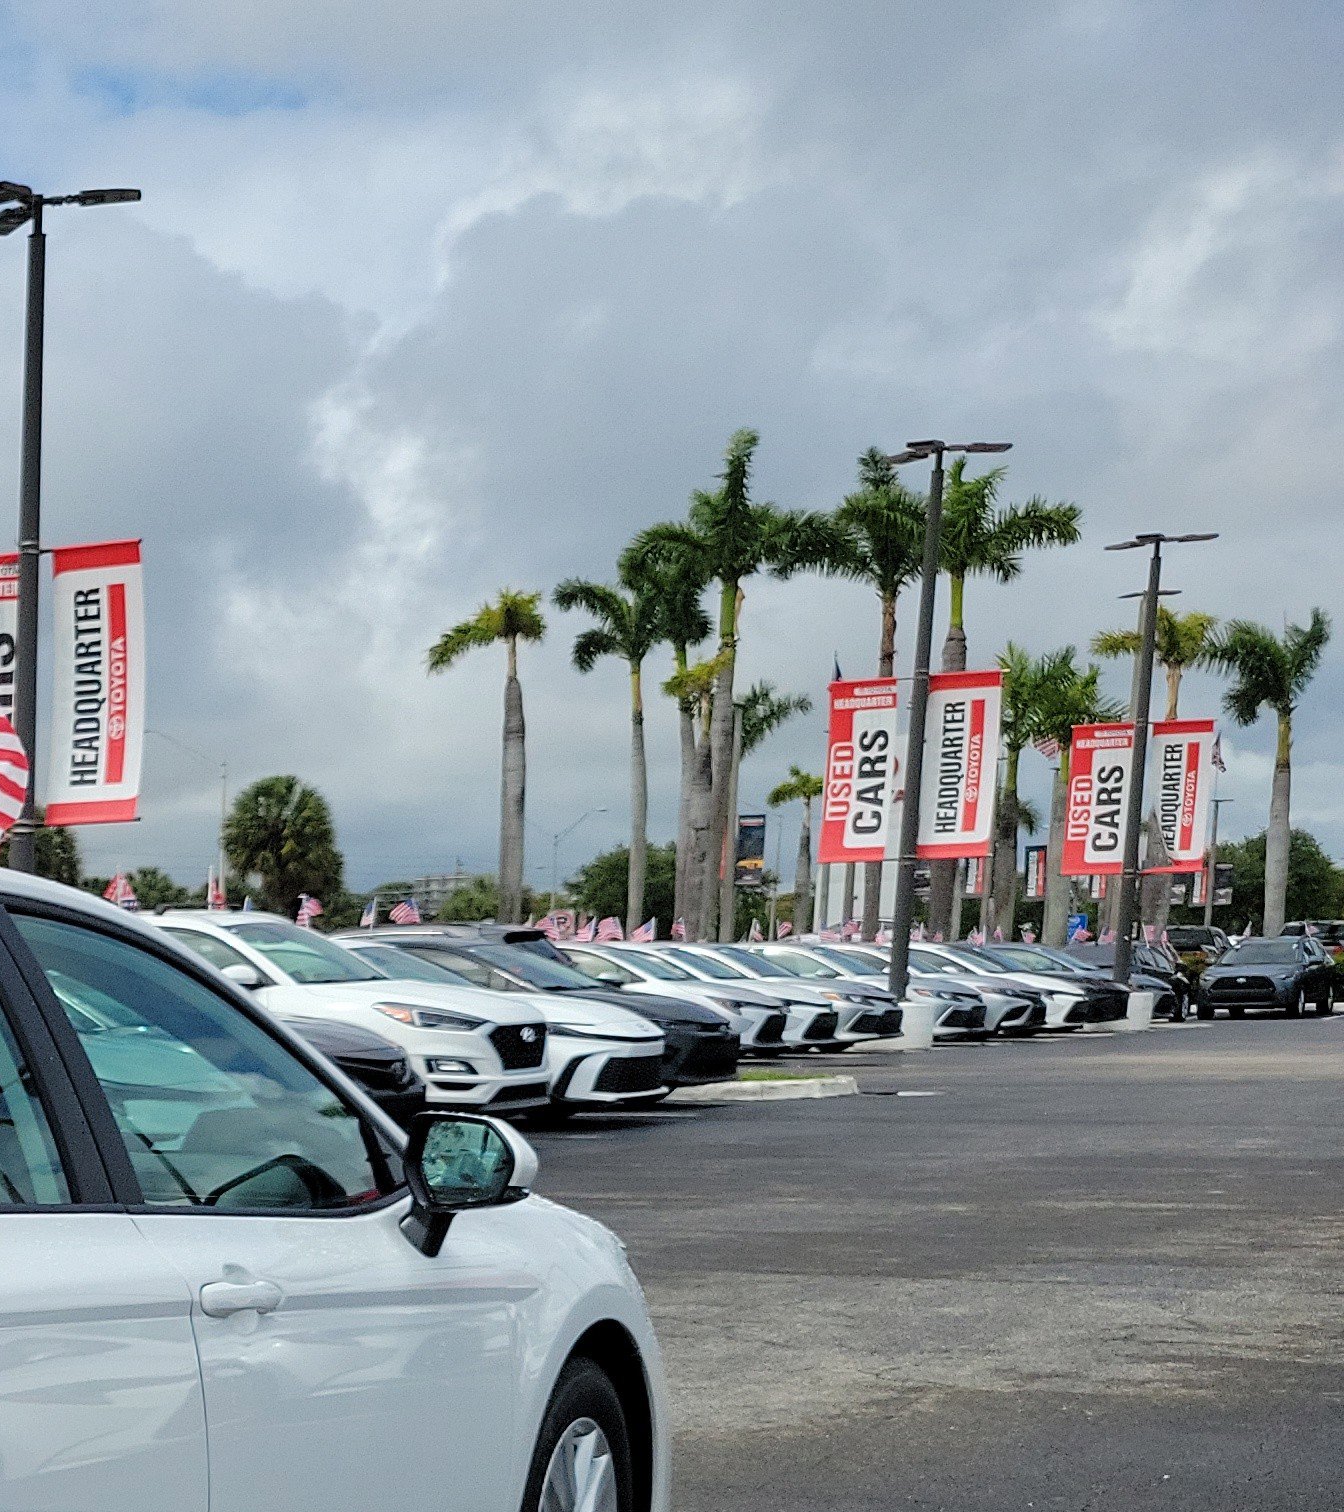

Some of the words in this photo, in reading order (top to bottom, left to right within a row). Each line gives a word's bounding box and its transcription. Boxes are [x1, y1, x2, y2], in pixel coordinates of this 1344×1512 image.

[69, 586, 106, 786] HEADQUARTER
[110, 636, 126, 711] TOYOTA
[828, 745, 854, 818] USED
[852, 729, 889, 835] CARS
[934, 701, 965, 833] HEADQUARTER
[967, 734, 981, 785] TOYOTA
[1184, 770, 1197, 812] TOYOTA
[1070, 775, 1093, 837] USED
[1091, 765, 1124, 852] CARS
